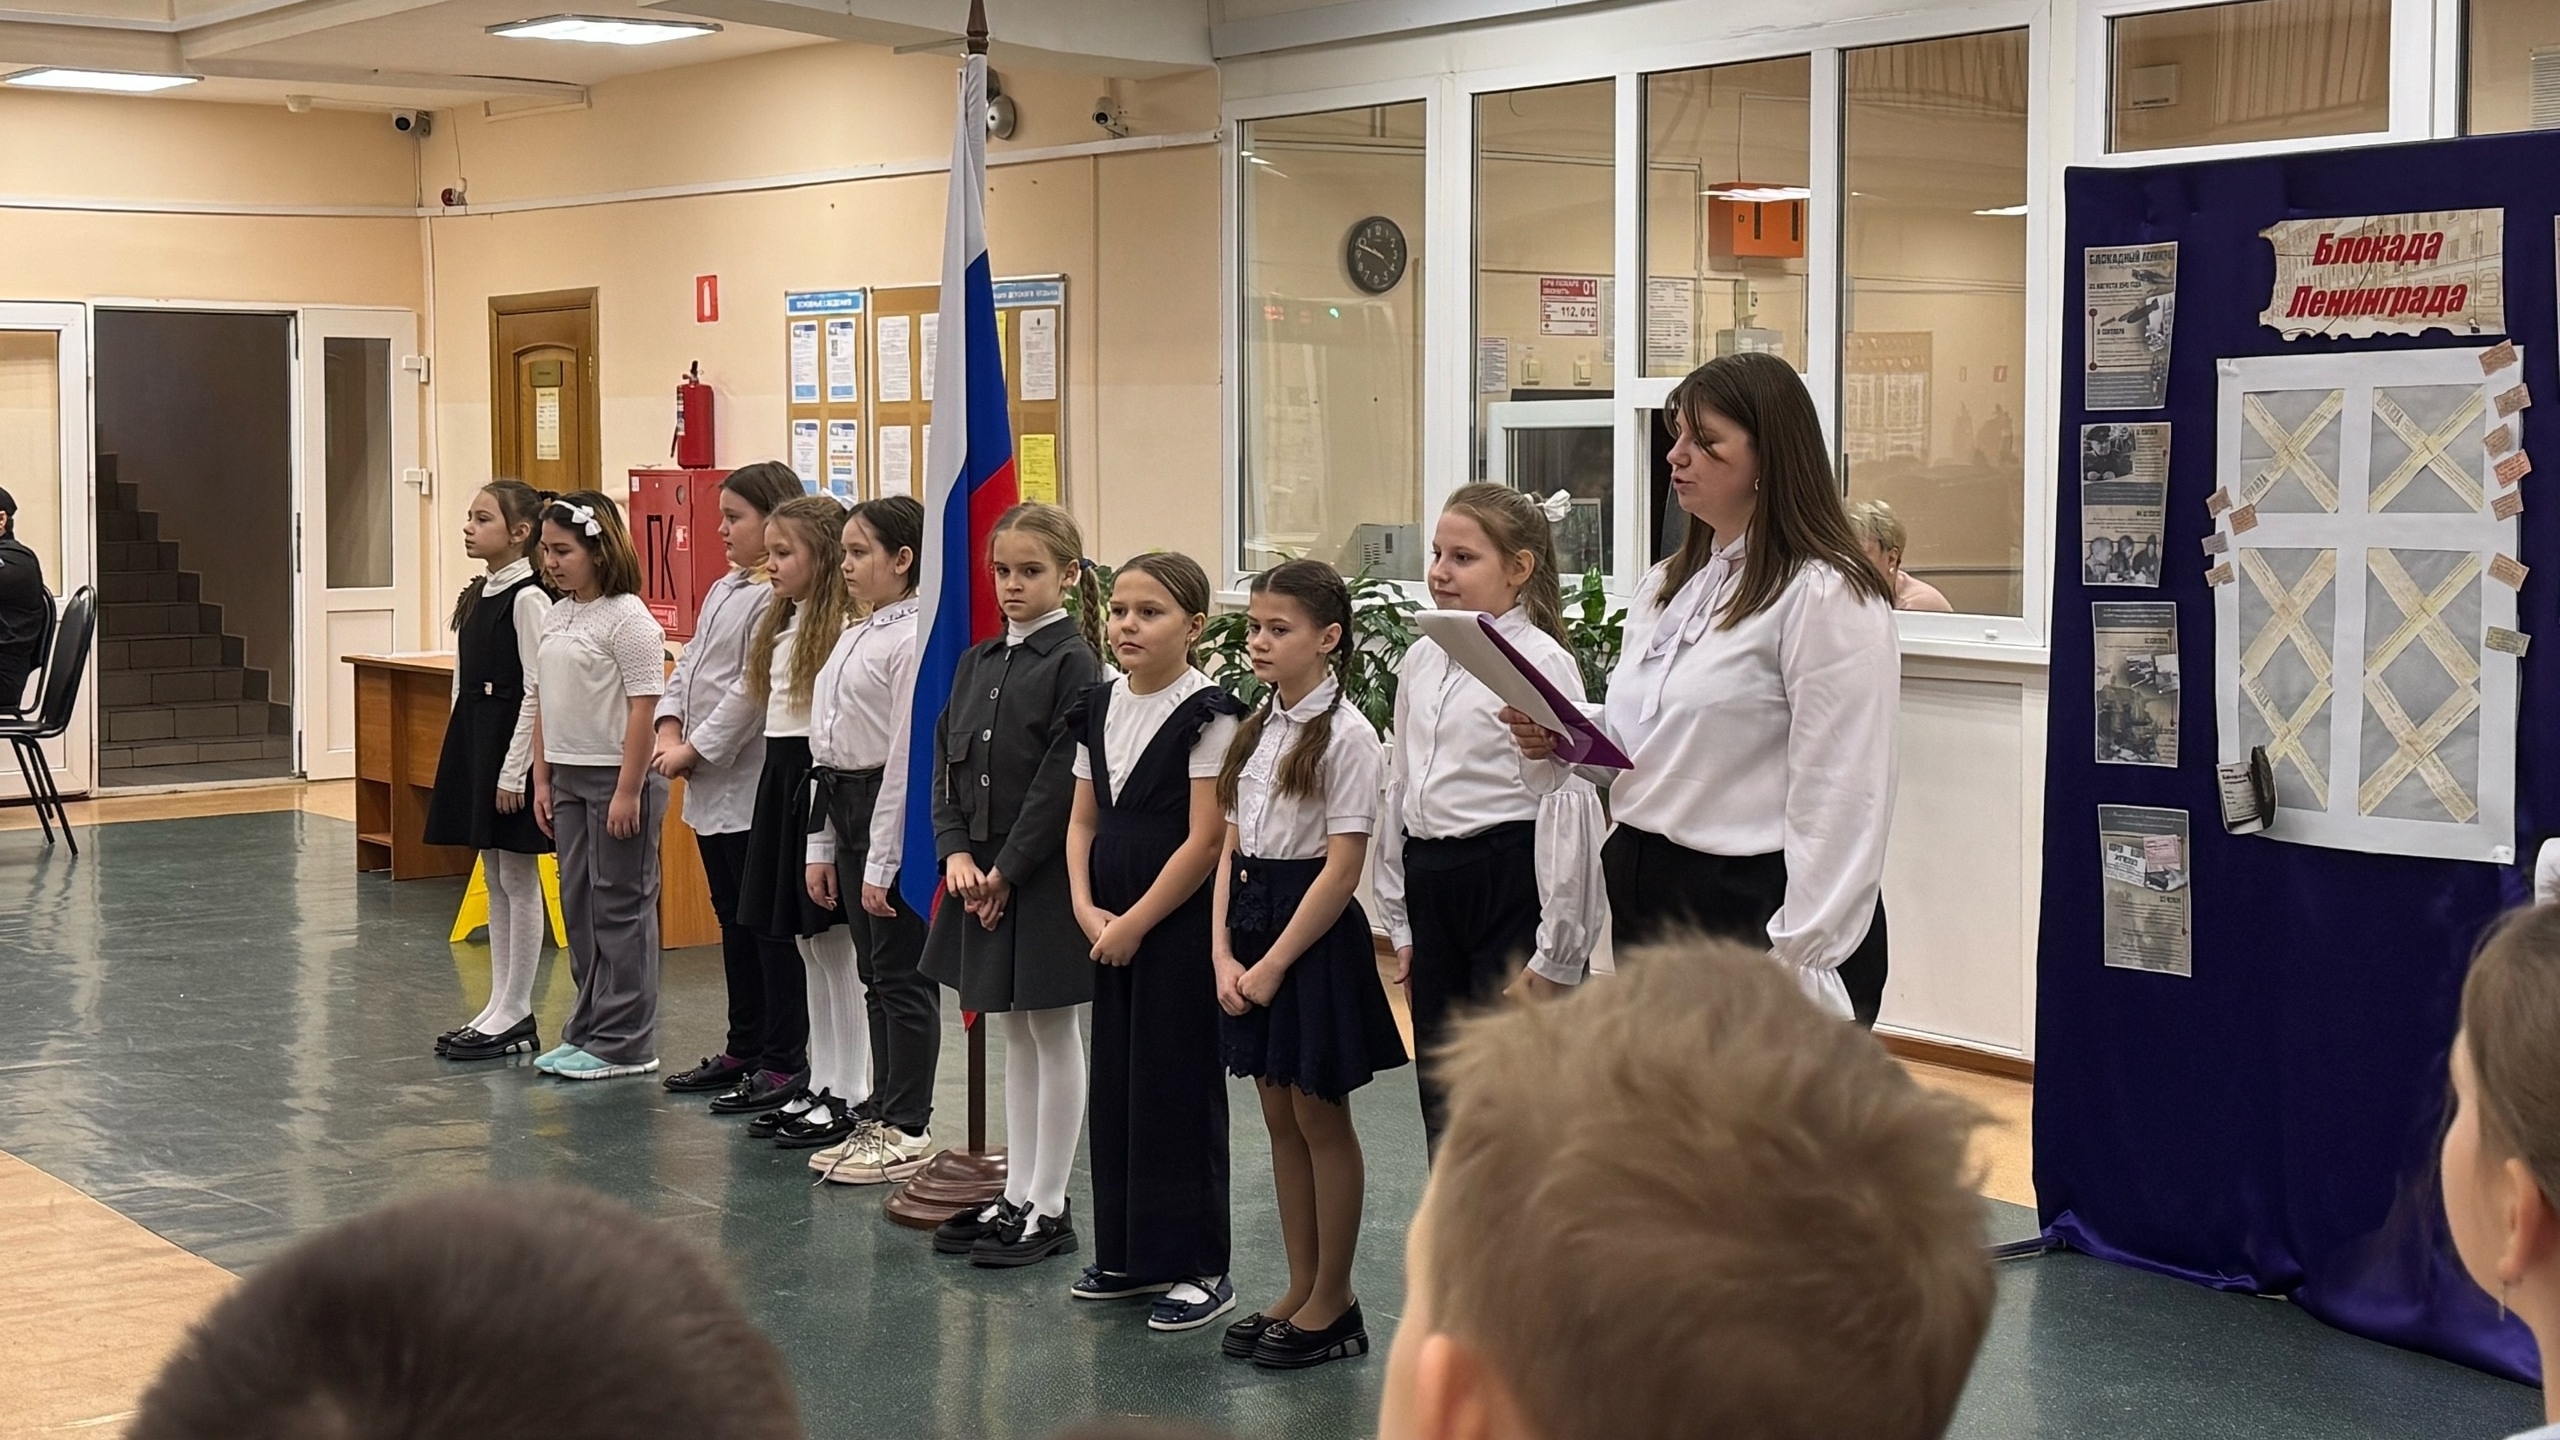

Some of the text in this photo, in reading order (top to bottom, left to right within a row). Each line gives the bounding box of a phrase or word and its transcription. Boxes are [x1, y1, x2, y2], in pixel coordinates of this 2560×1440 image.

[2312, 232, 2444, 266] Блокада
[1582, 281, 1595, 296] 01
[2285, 283, 2468, 318] Ленинграда
[647, 514, 676, 600] ПК
